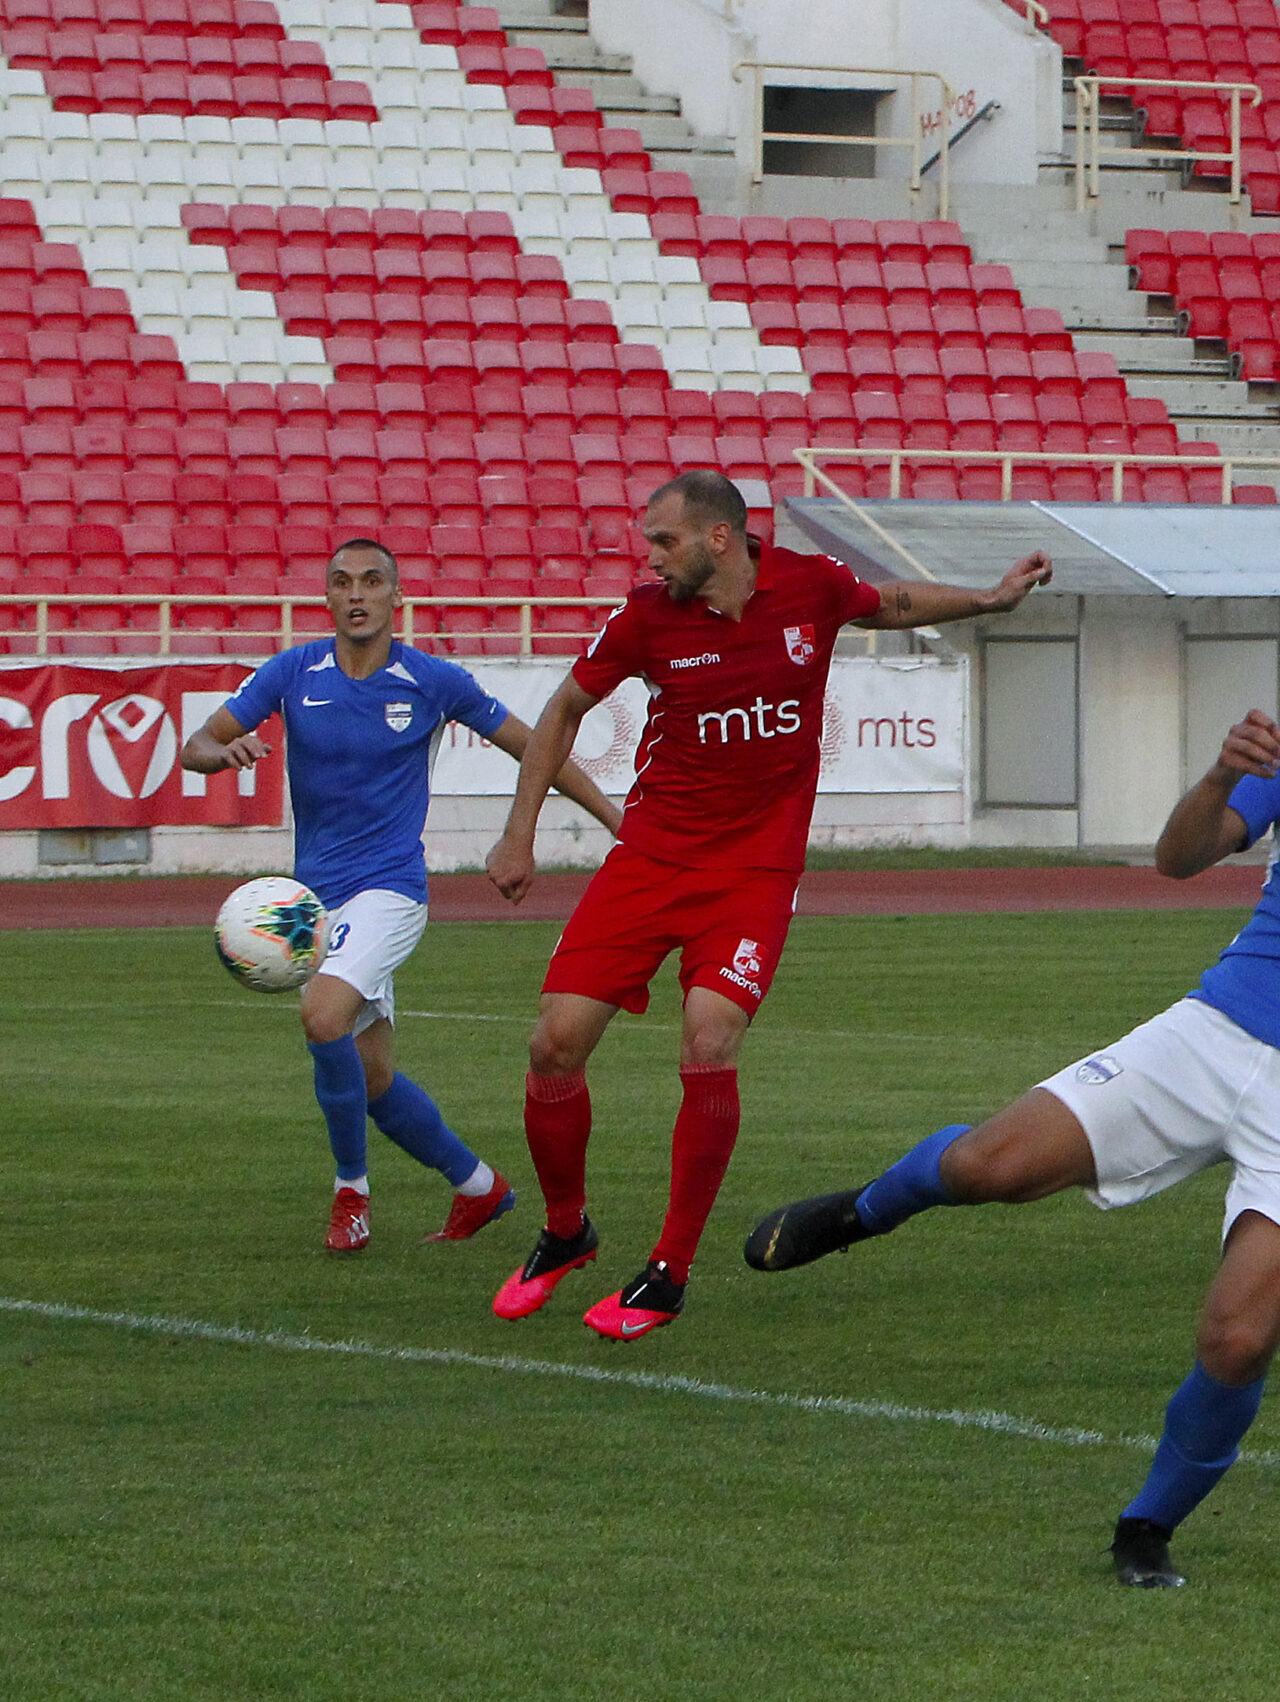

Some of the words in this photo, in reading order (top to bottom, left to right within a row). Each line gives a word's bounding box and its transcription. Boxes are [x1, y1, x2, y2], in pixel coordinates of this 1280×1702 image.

[669, 652, 721, 670] macron
[697, 696, 801, 745] mts
[857, 710, 937, 748] mts
[718, 965, 763, 1000] macron
